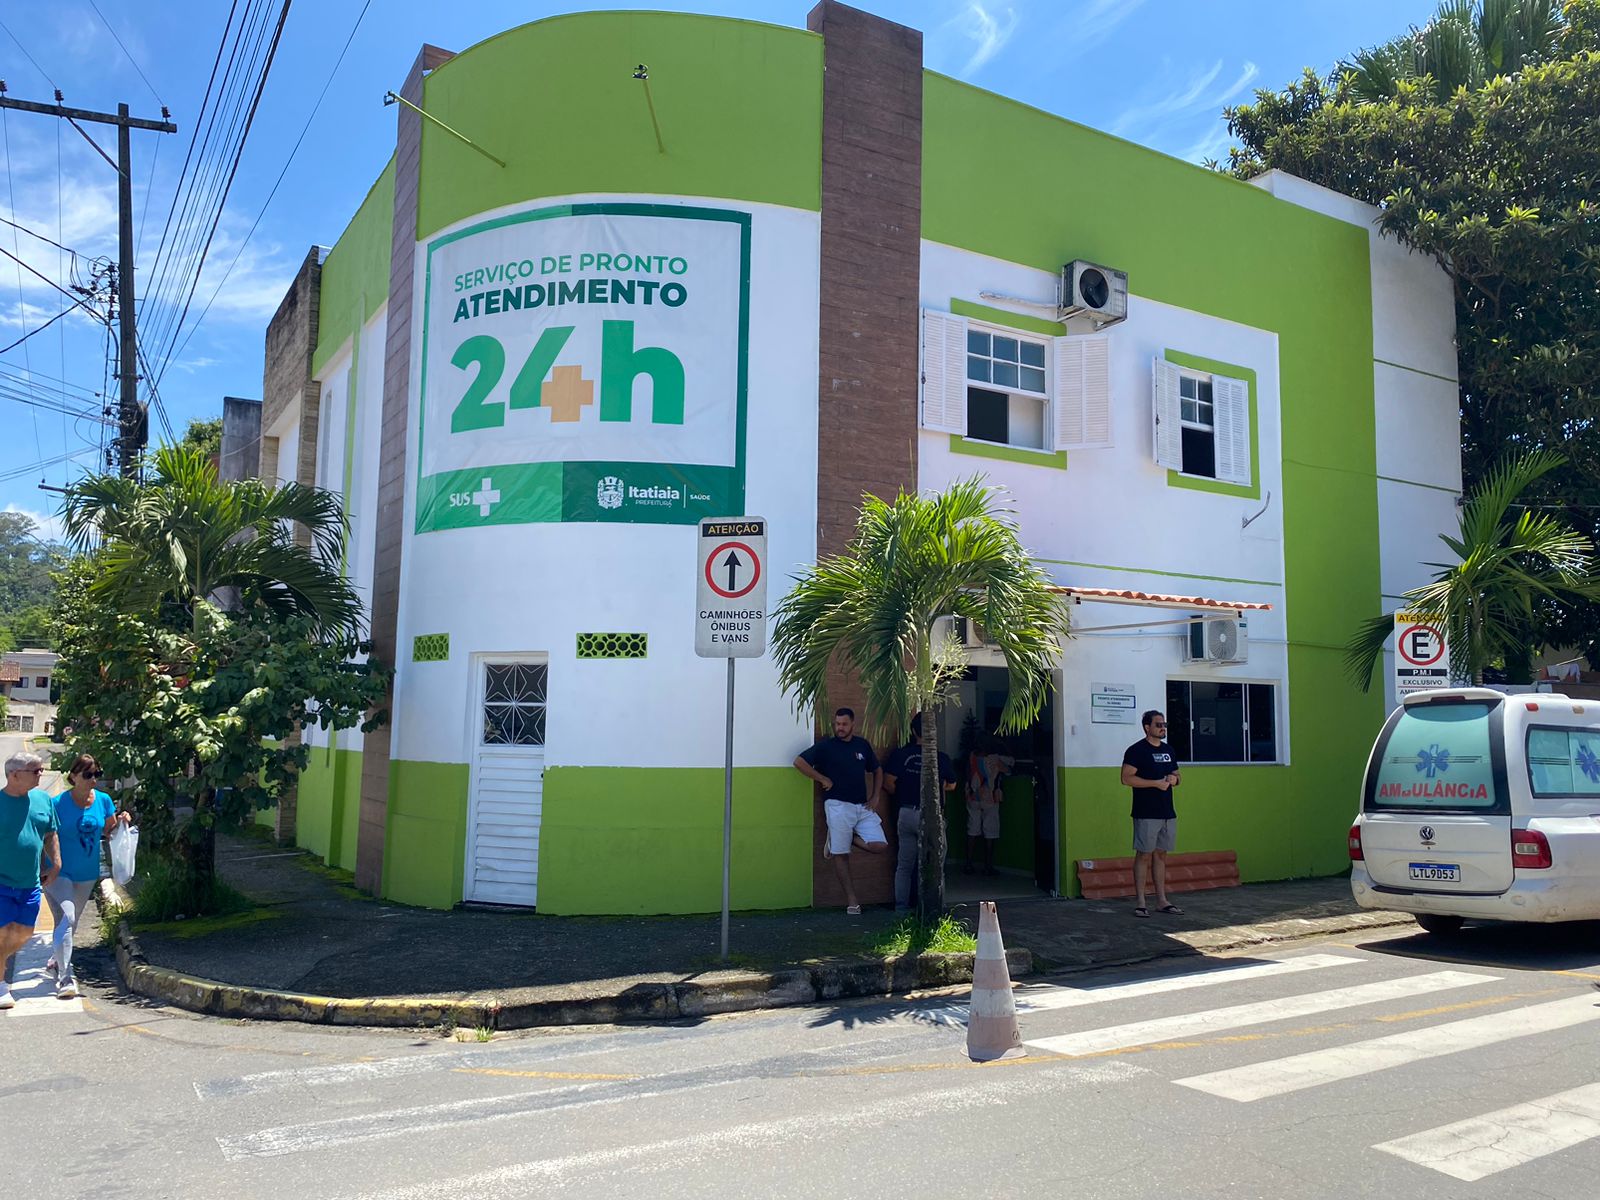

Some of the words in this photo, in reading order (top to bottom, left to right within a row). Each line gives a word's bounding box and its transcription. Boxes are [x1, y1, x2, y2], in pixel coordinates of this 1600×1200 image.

[454, 259, 534, 293] SERVIÇO
[540, 254, 572, 275] DE
[579, 253, 688, 275] PRONTO
[453, 279, 688, 323] ATENDIMENTO
[450, 319, 686, 434] 24h
[449, 491, 471, 507] SUS
[628, 486, 680, 500] Itatiaia
[689, 493, 711, 501] SAÚDE
[635, 499, 673, 507] PREFEITURA
[707, 523, 759, 535] ATENÇÃO
[700, 609, 763, 620] CAMINHÕES
[710, 620, 751, 631] ÔNIBUS
[711, 633, 718, 643] E
[721, 634, 749, 643] VANS
[1412, 632, 1431, 658] E
